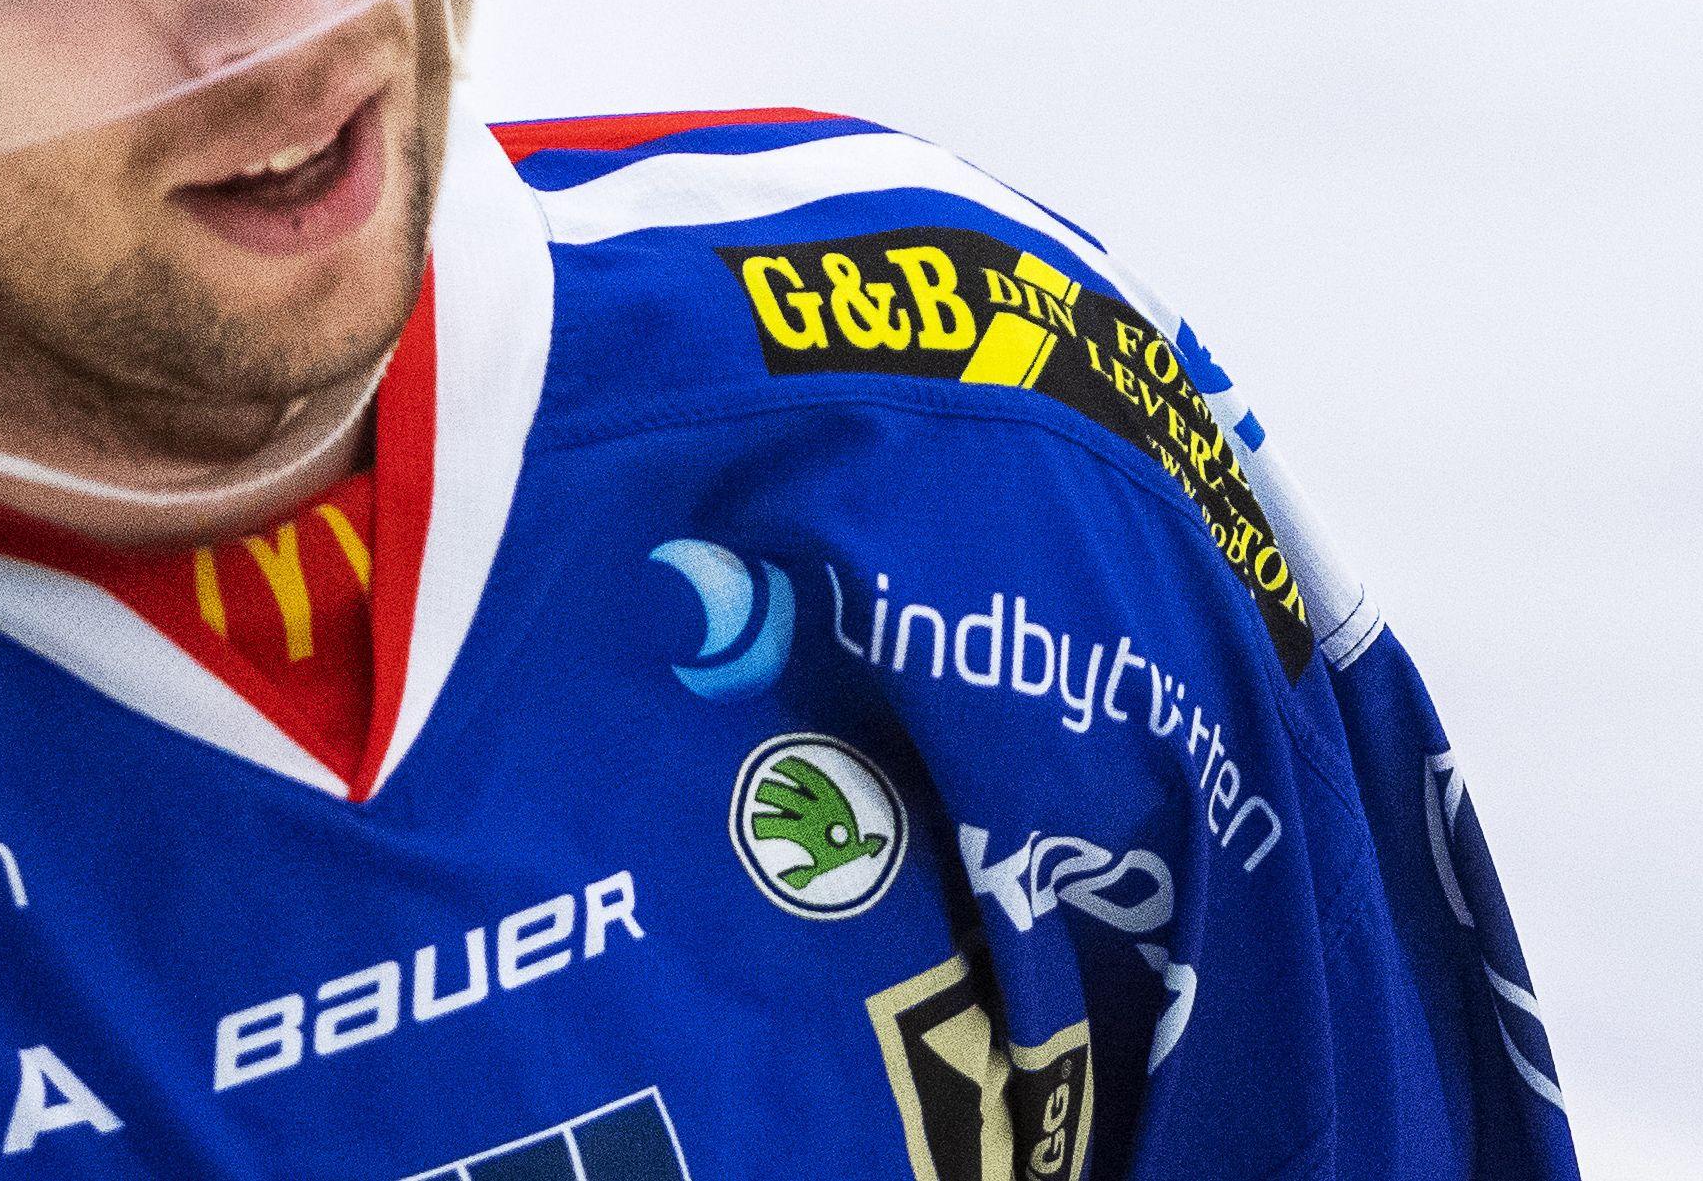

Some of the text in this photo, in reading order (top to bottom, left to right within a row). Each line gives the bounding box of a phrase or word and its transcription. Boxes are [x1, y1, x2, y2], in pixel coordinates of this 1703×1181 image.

[742, 245, 1076, 352] G&B DIN
[213, 869, 646, 1093] BAUER
